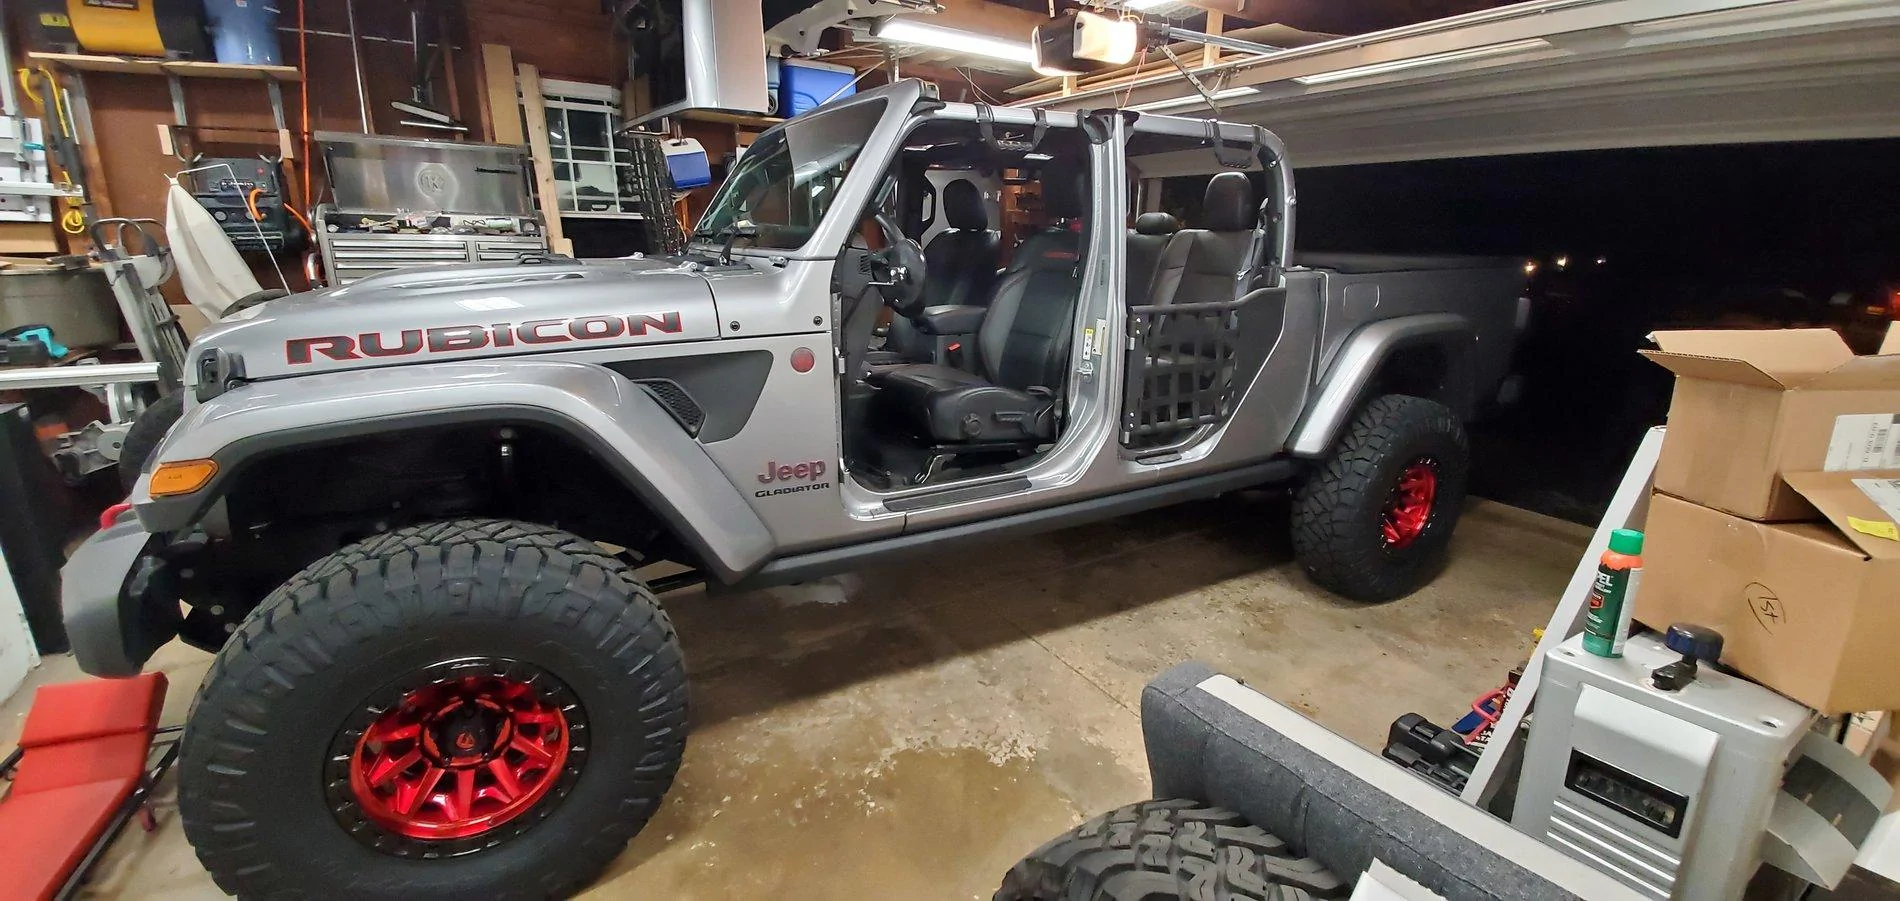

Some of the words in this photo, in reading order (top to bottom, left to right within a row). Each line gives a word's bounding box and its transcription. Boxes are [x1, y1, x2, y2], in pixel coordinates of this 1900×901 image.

[286, 311, 683, 365] RUBICON
[757, 460, 826, 484] Jeep
[755, 482, 830, 498] GLADIATOR
